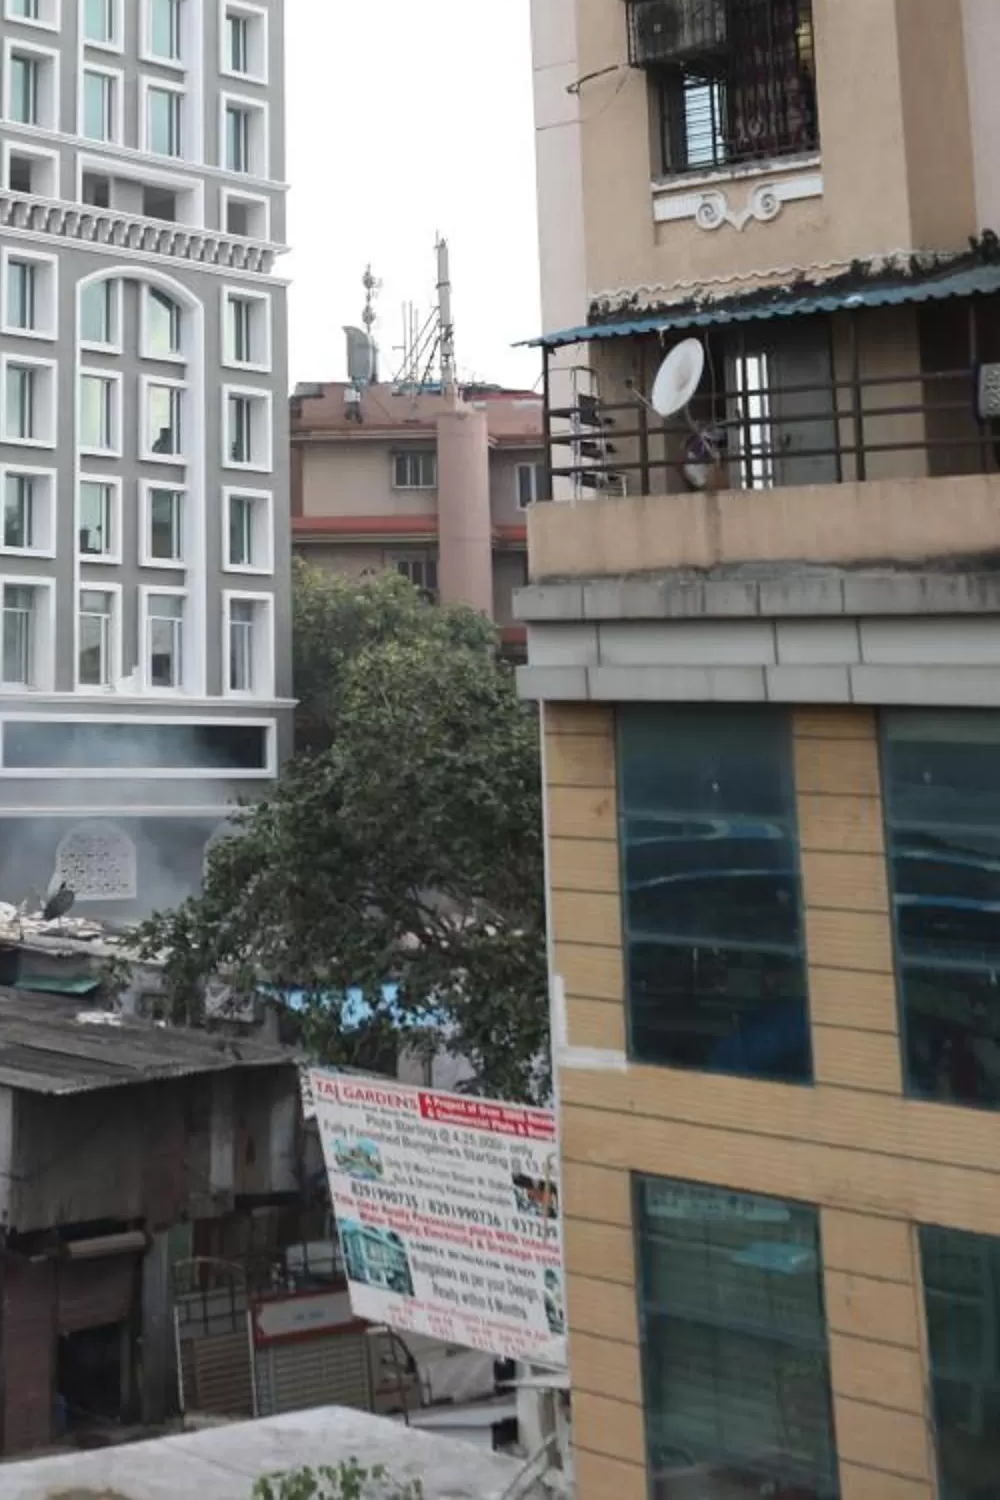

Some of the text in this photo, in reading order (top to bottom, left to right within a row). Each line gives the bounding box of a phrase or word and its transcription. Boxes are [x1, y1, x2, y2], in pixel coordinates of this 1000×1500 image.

[316, 1081, 338, 1097] TAJ
[343, 1086, 417, 1112] GARDENS
[395, 1119, 436, 1140] Starting
